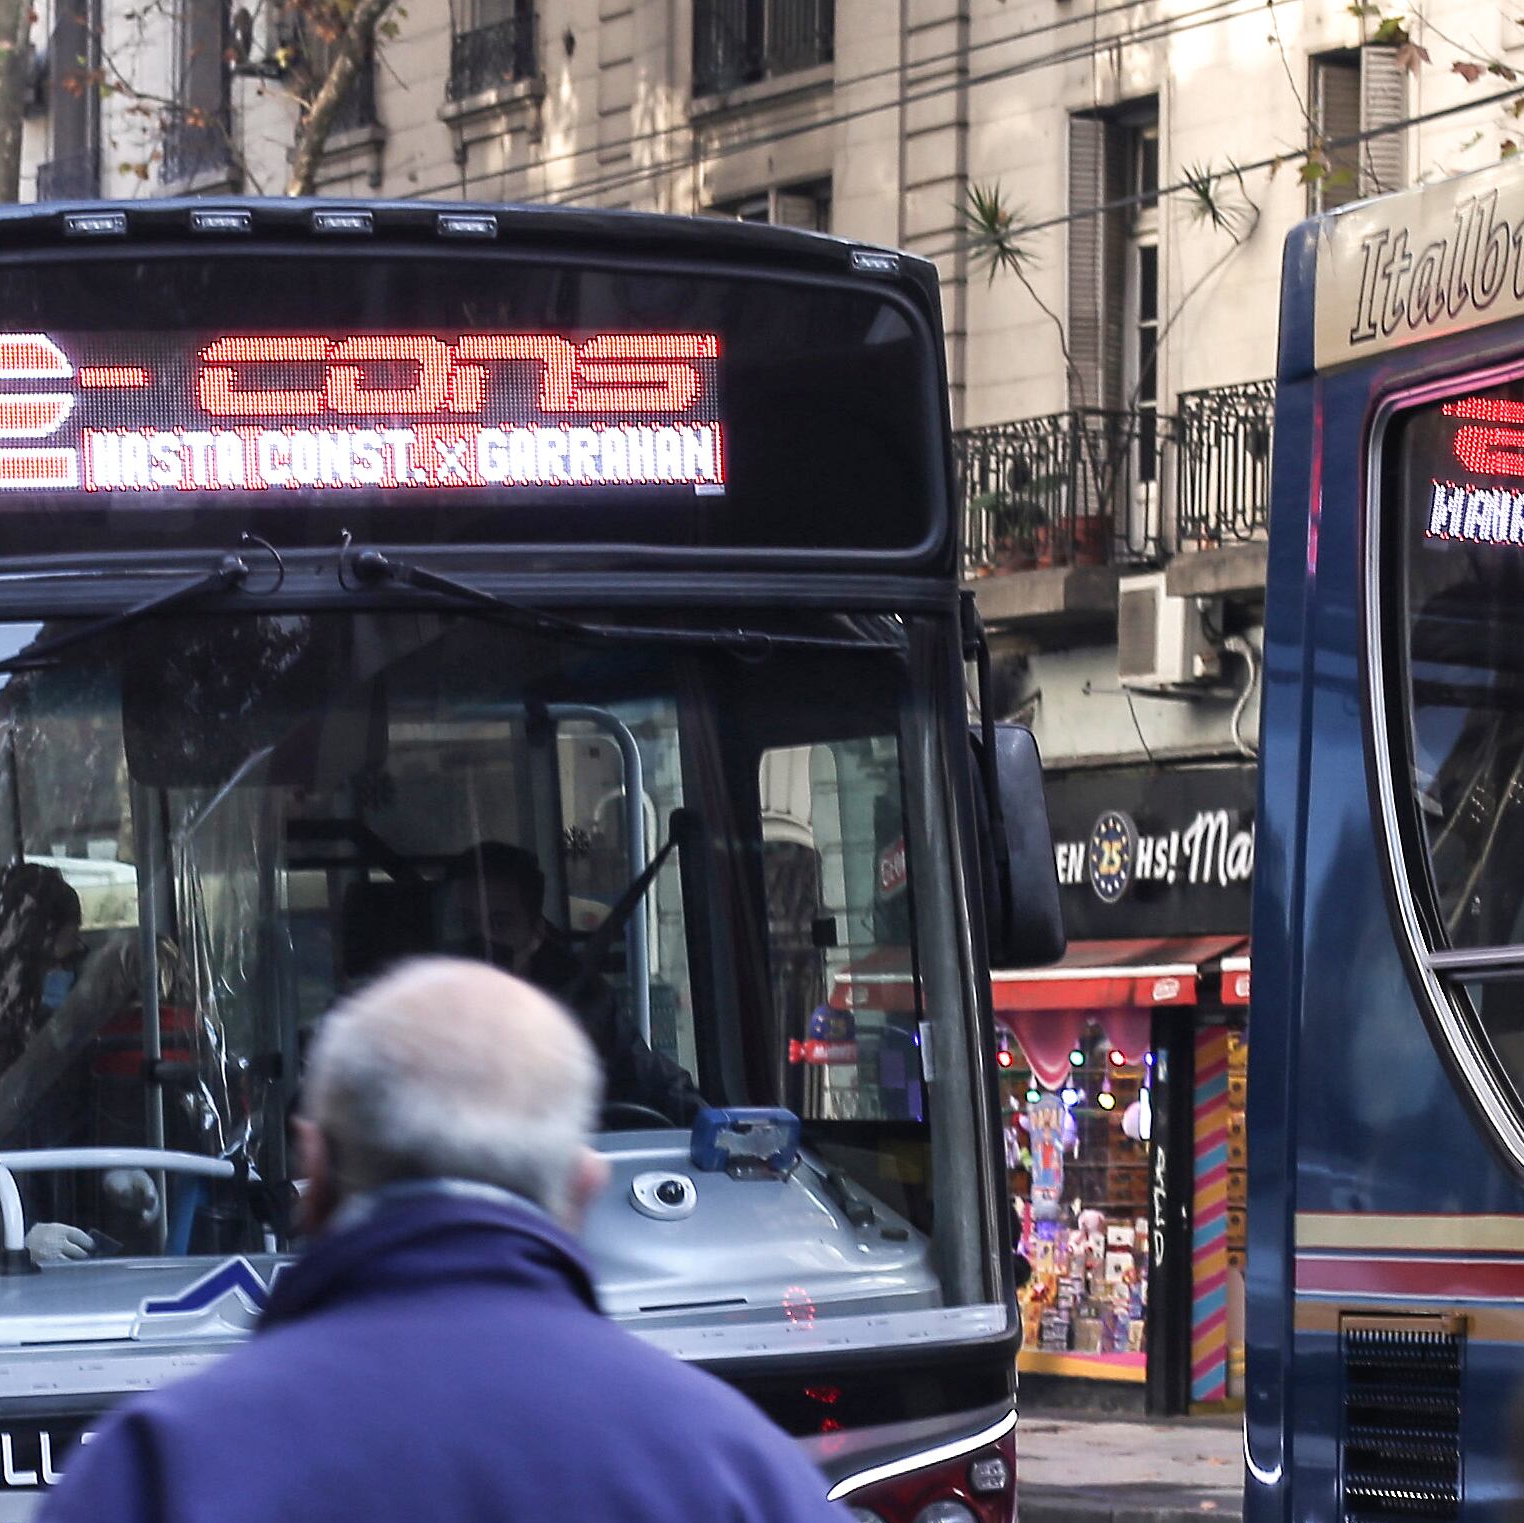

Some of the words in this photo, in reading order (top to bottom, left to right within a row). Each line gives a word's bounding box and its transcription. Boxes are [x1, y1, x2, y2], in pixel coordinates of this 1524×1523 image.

[89, 426, 241, 489] HASTA
[259, 426, 427, 486] CONST.
[478, 426, 716, 484] GARRAHAN
[1099, 839, 1123, 876] 25
[1135, 830, 1179, 885] HS!
